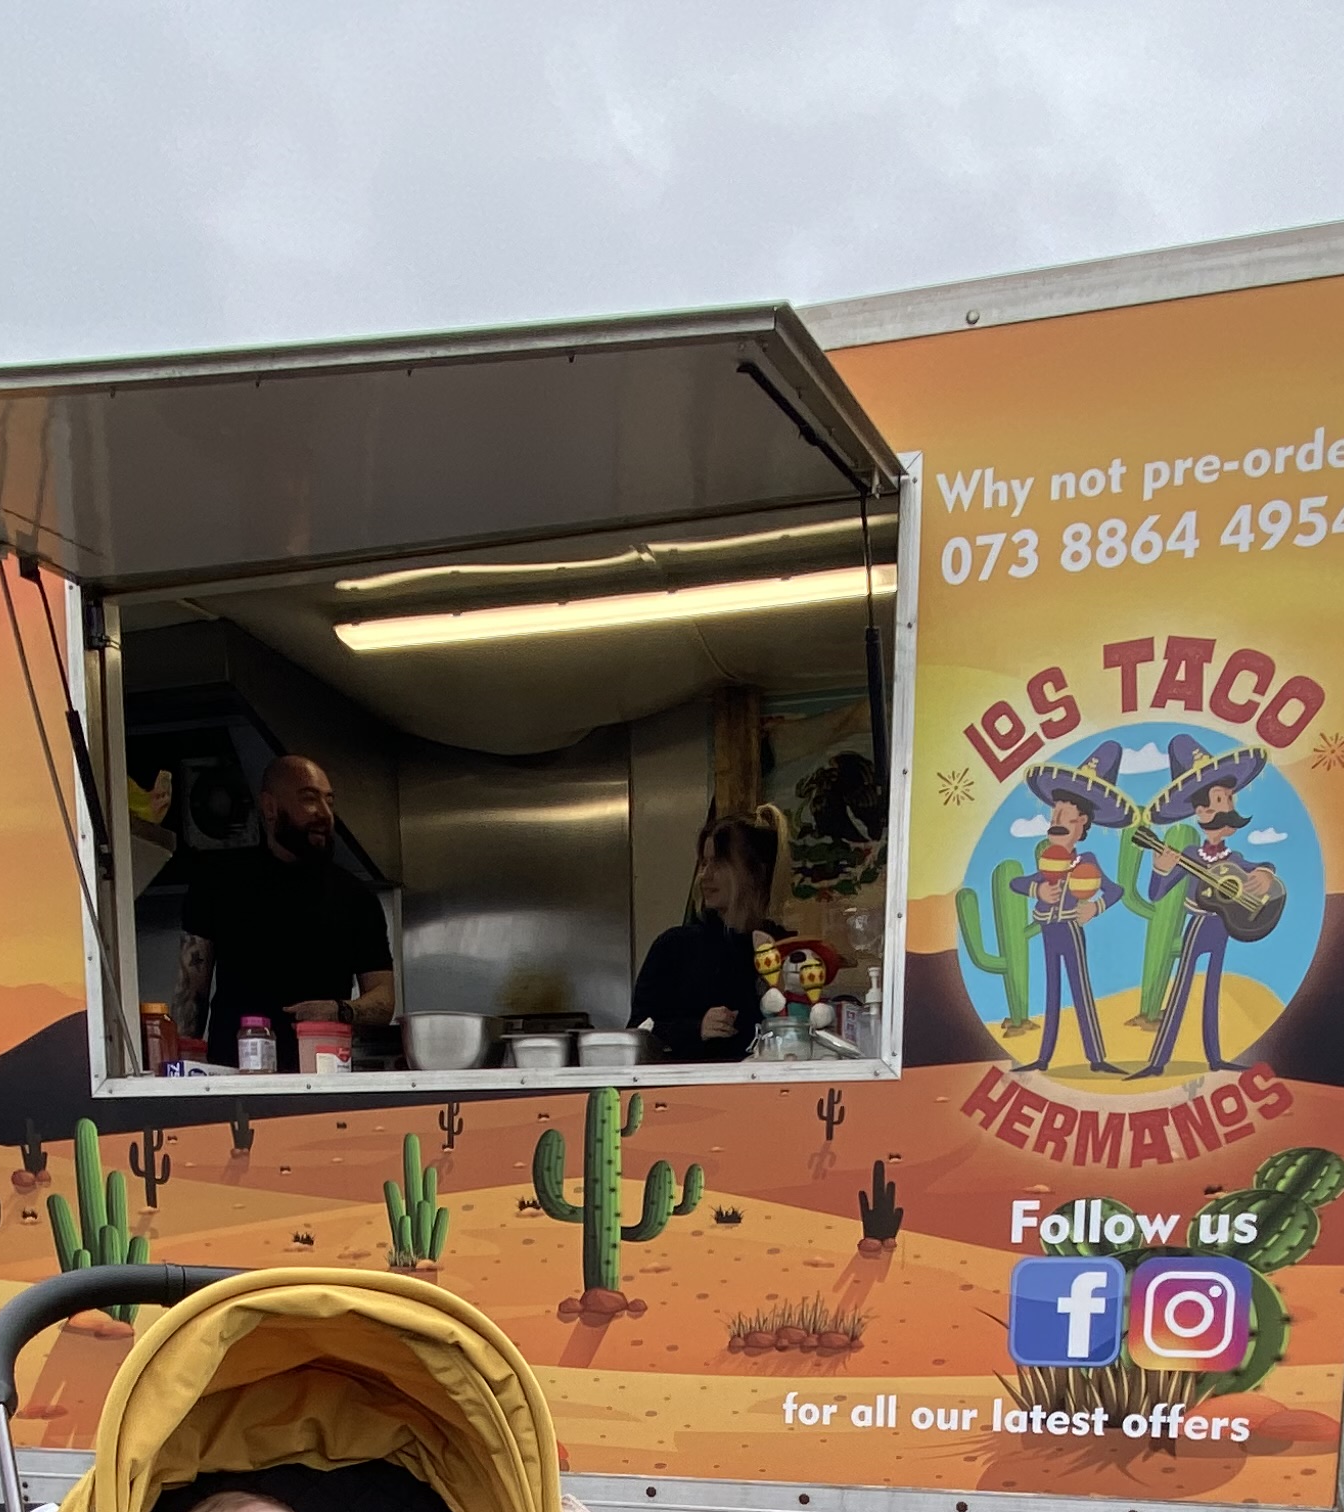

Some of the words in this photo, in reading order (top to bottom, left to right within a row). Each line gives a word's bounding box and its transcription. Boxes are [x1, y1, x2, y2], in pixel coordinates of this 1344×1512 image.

[935, 467, 1035, 517] Why
[1049, 458, 1124, 501] not
[941, 528, 1040, 586] 073
[1060, 510, 1199, 573] 8864
[962, 665, 1081, 783] LOS
[1102, 635, 1326, 749] TACO
[959, 1062, 1295, 1170] HERMANOS
[1010, 1198, 1180, 1246] Follow
[1198, 1209, 1258, 1245] us
[782, 1392, 838, 1427] for
[849, 1394, 898, 1429] all
[910, 1405, 978, 1433] our
[991, 1397, 1108, 1438] latest
[1121, 1403, 1251, 1443] offers
